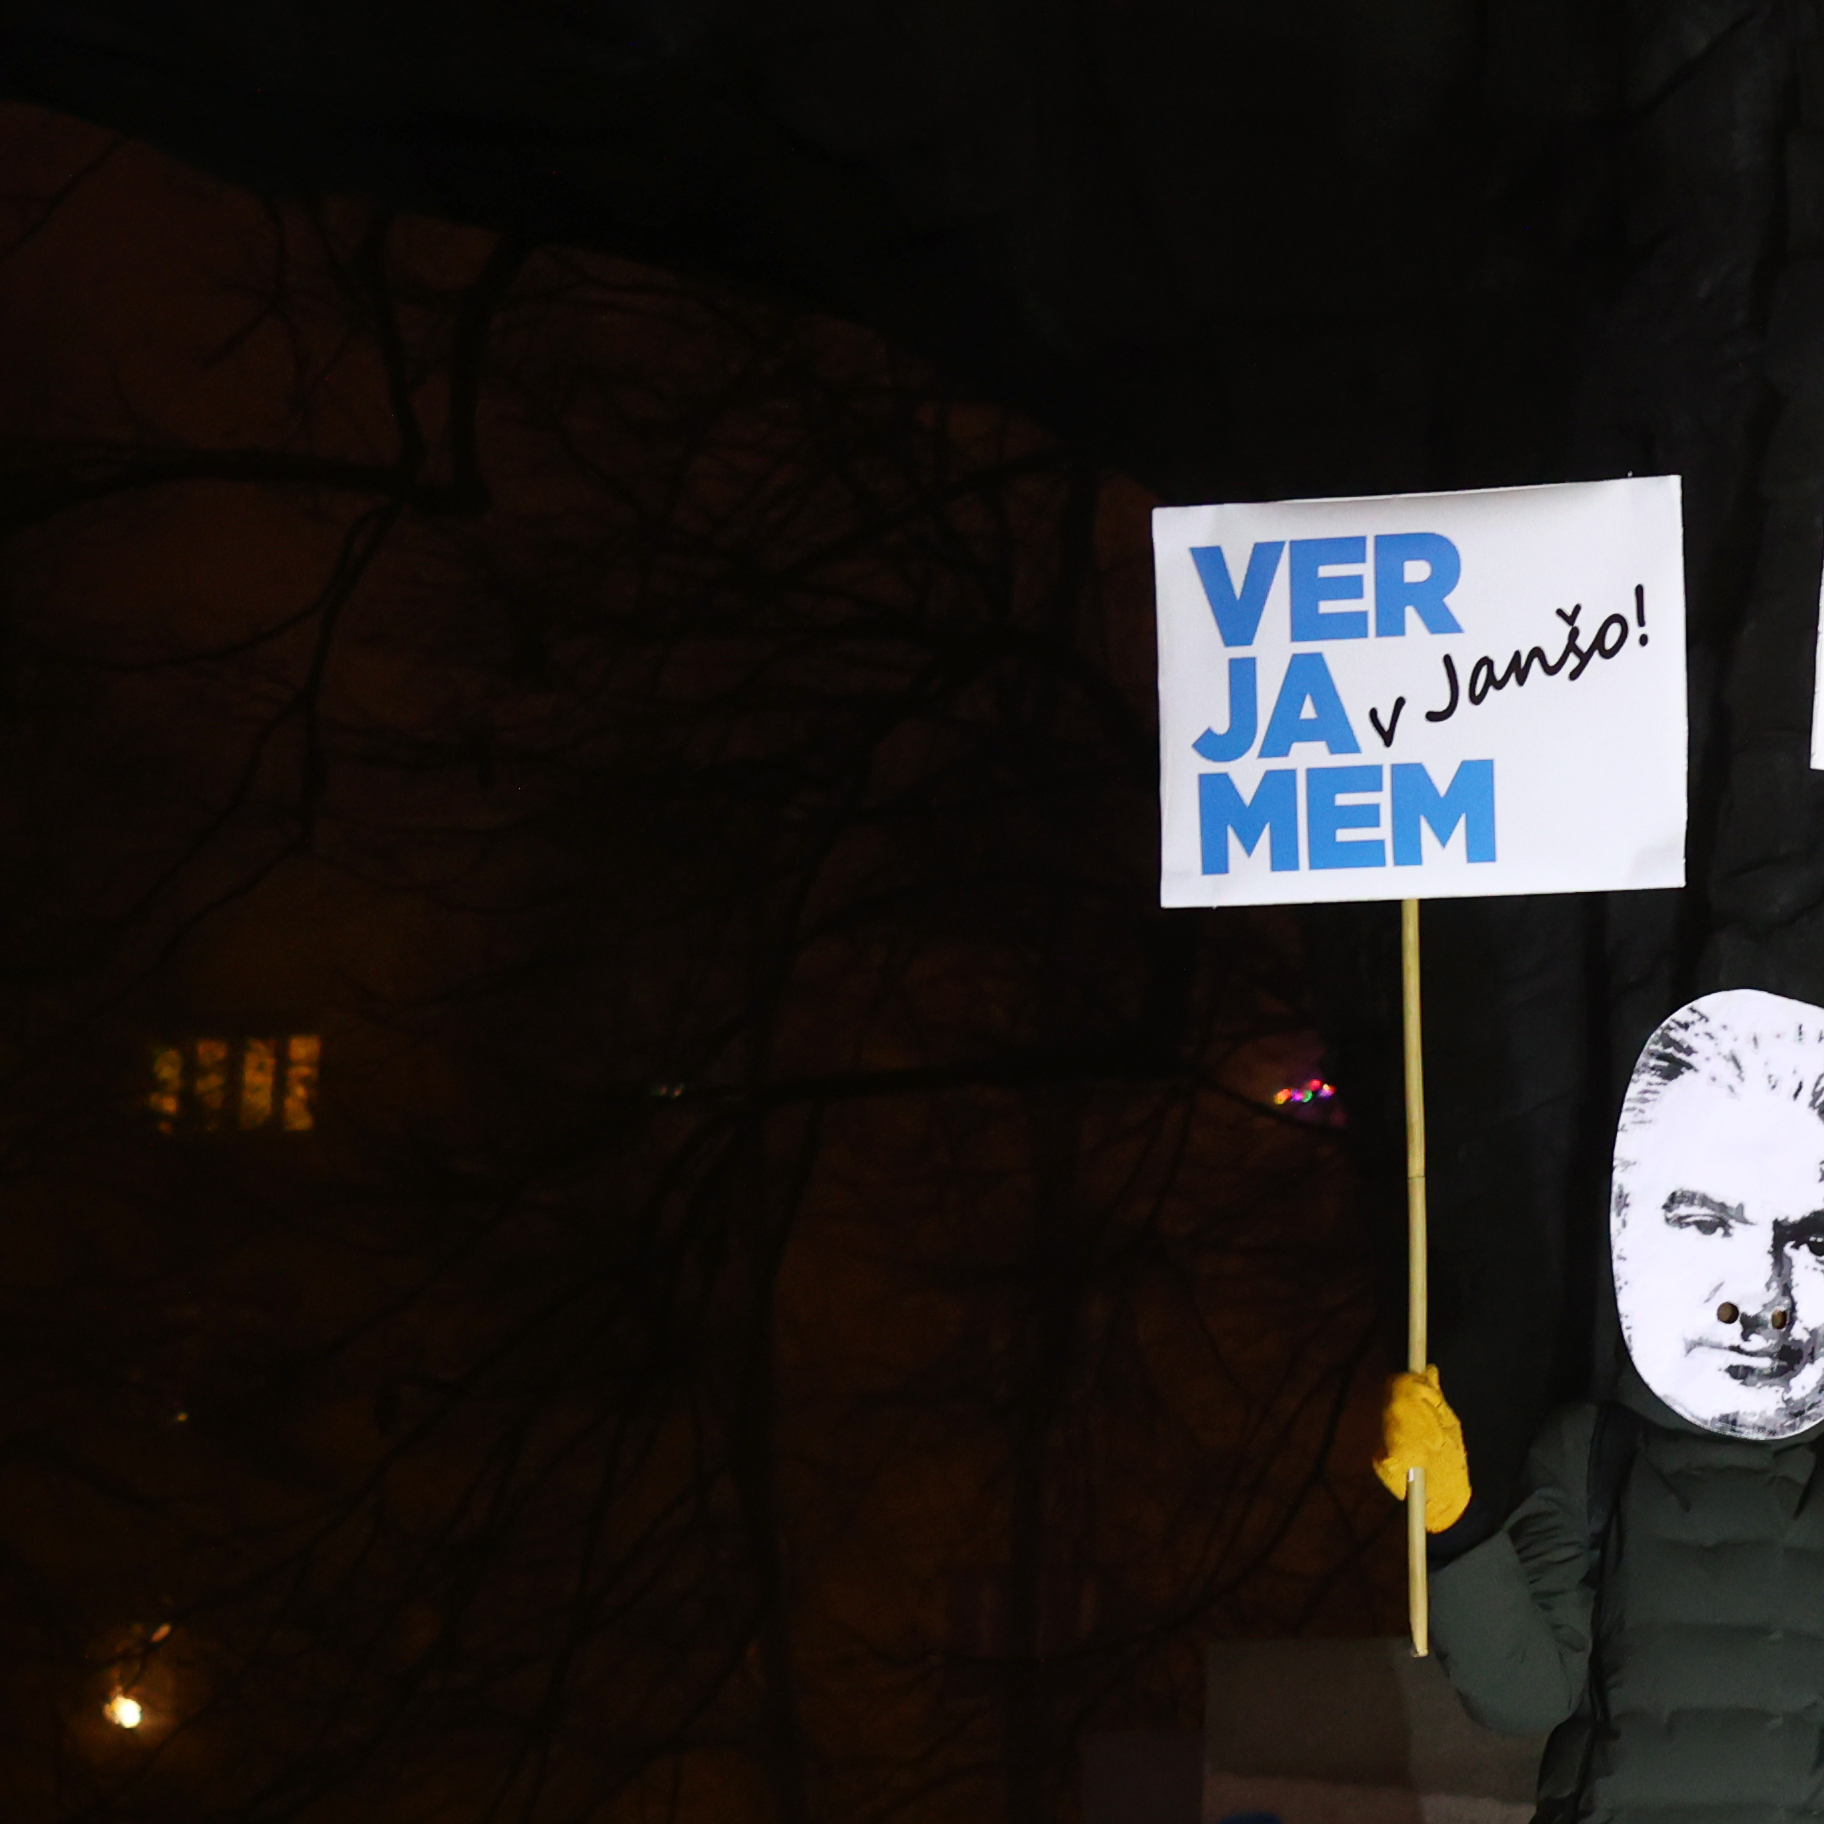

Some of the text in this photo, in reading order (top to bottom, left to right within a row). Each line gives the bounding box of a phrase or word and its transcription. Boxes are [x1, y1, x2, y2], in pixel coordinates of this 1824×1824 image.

[1190, 532, 1463, 648] VER
[1192, 654, 1358, 763] JA
[1368, 584, 1649, 748] v Janšo!
[1198, 759, 1495, 876] MEM
